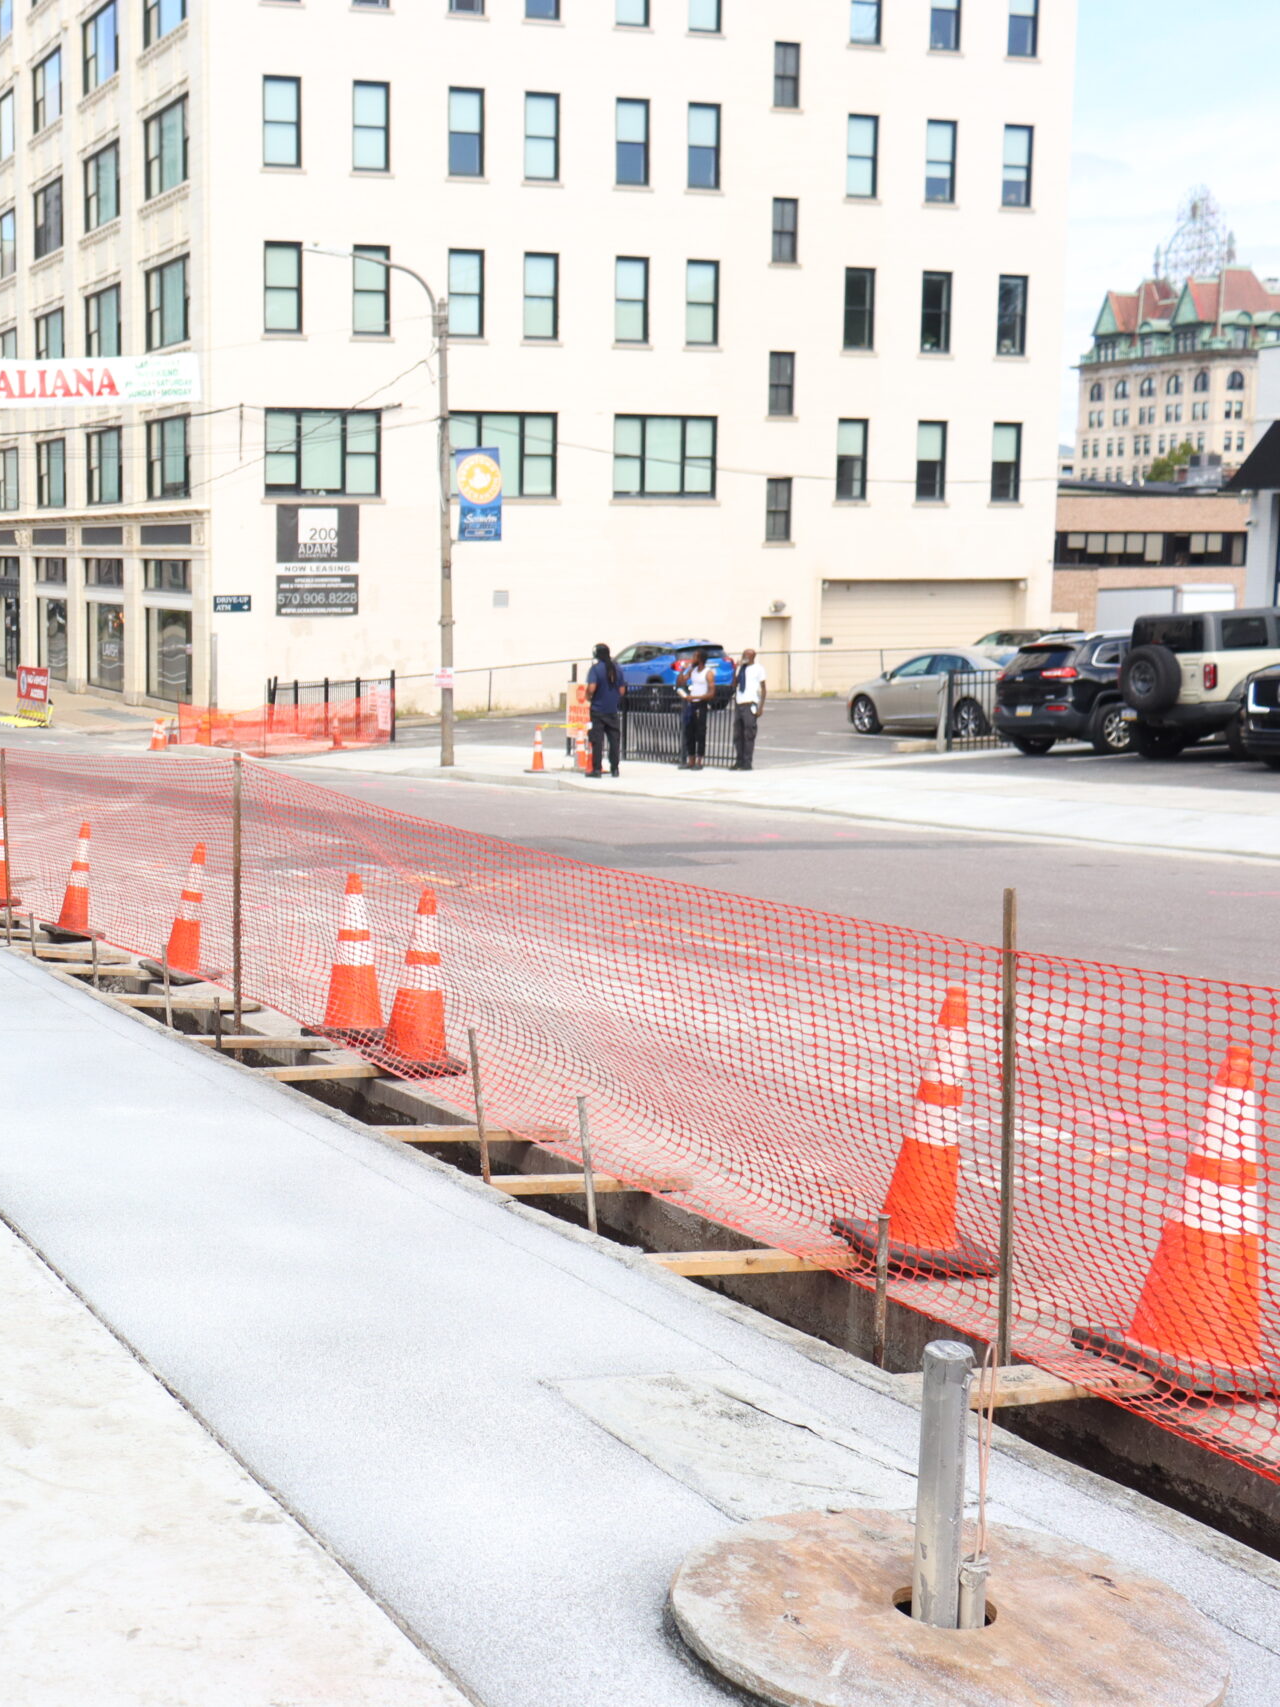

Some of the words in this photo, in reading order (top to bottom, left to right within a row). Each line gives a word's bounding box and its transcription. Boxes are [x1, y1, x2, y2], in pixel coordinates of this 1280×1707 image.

[309, 528, 338, 541] 200
[298, 543, 338, 554] ADAMS
[216, 596, 249, 604] DRIVE-UP
[277, 592, 358, 605] 570.906.8228
[569, 705, 591, 714] PRIVAT
